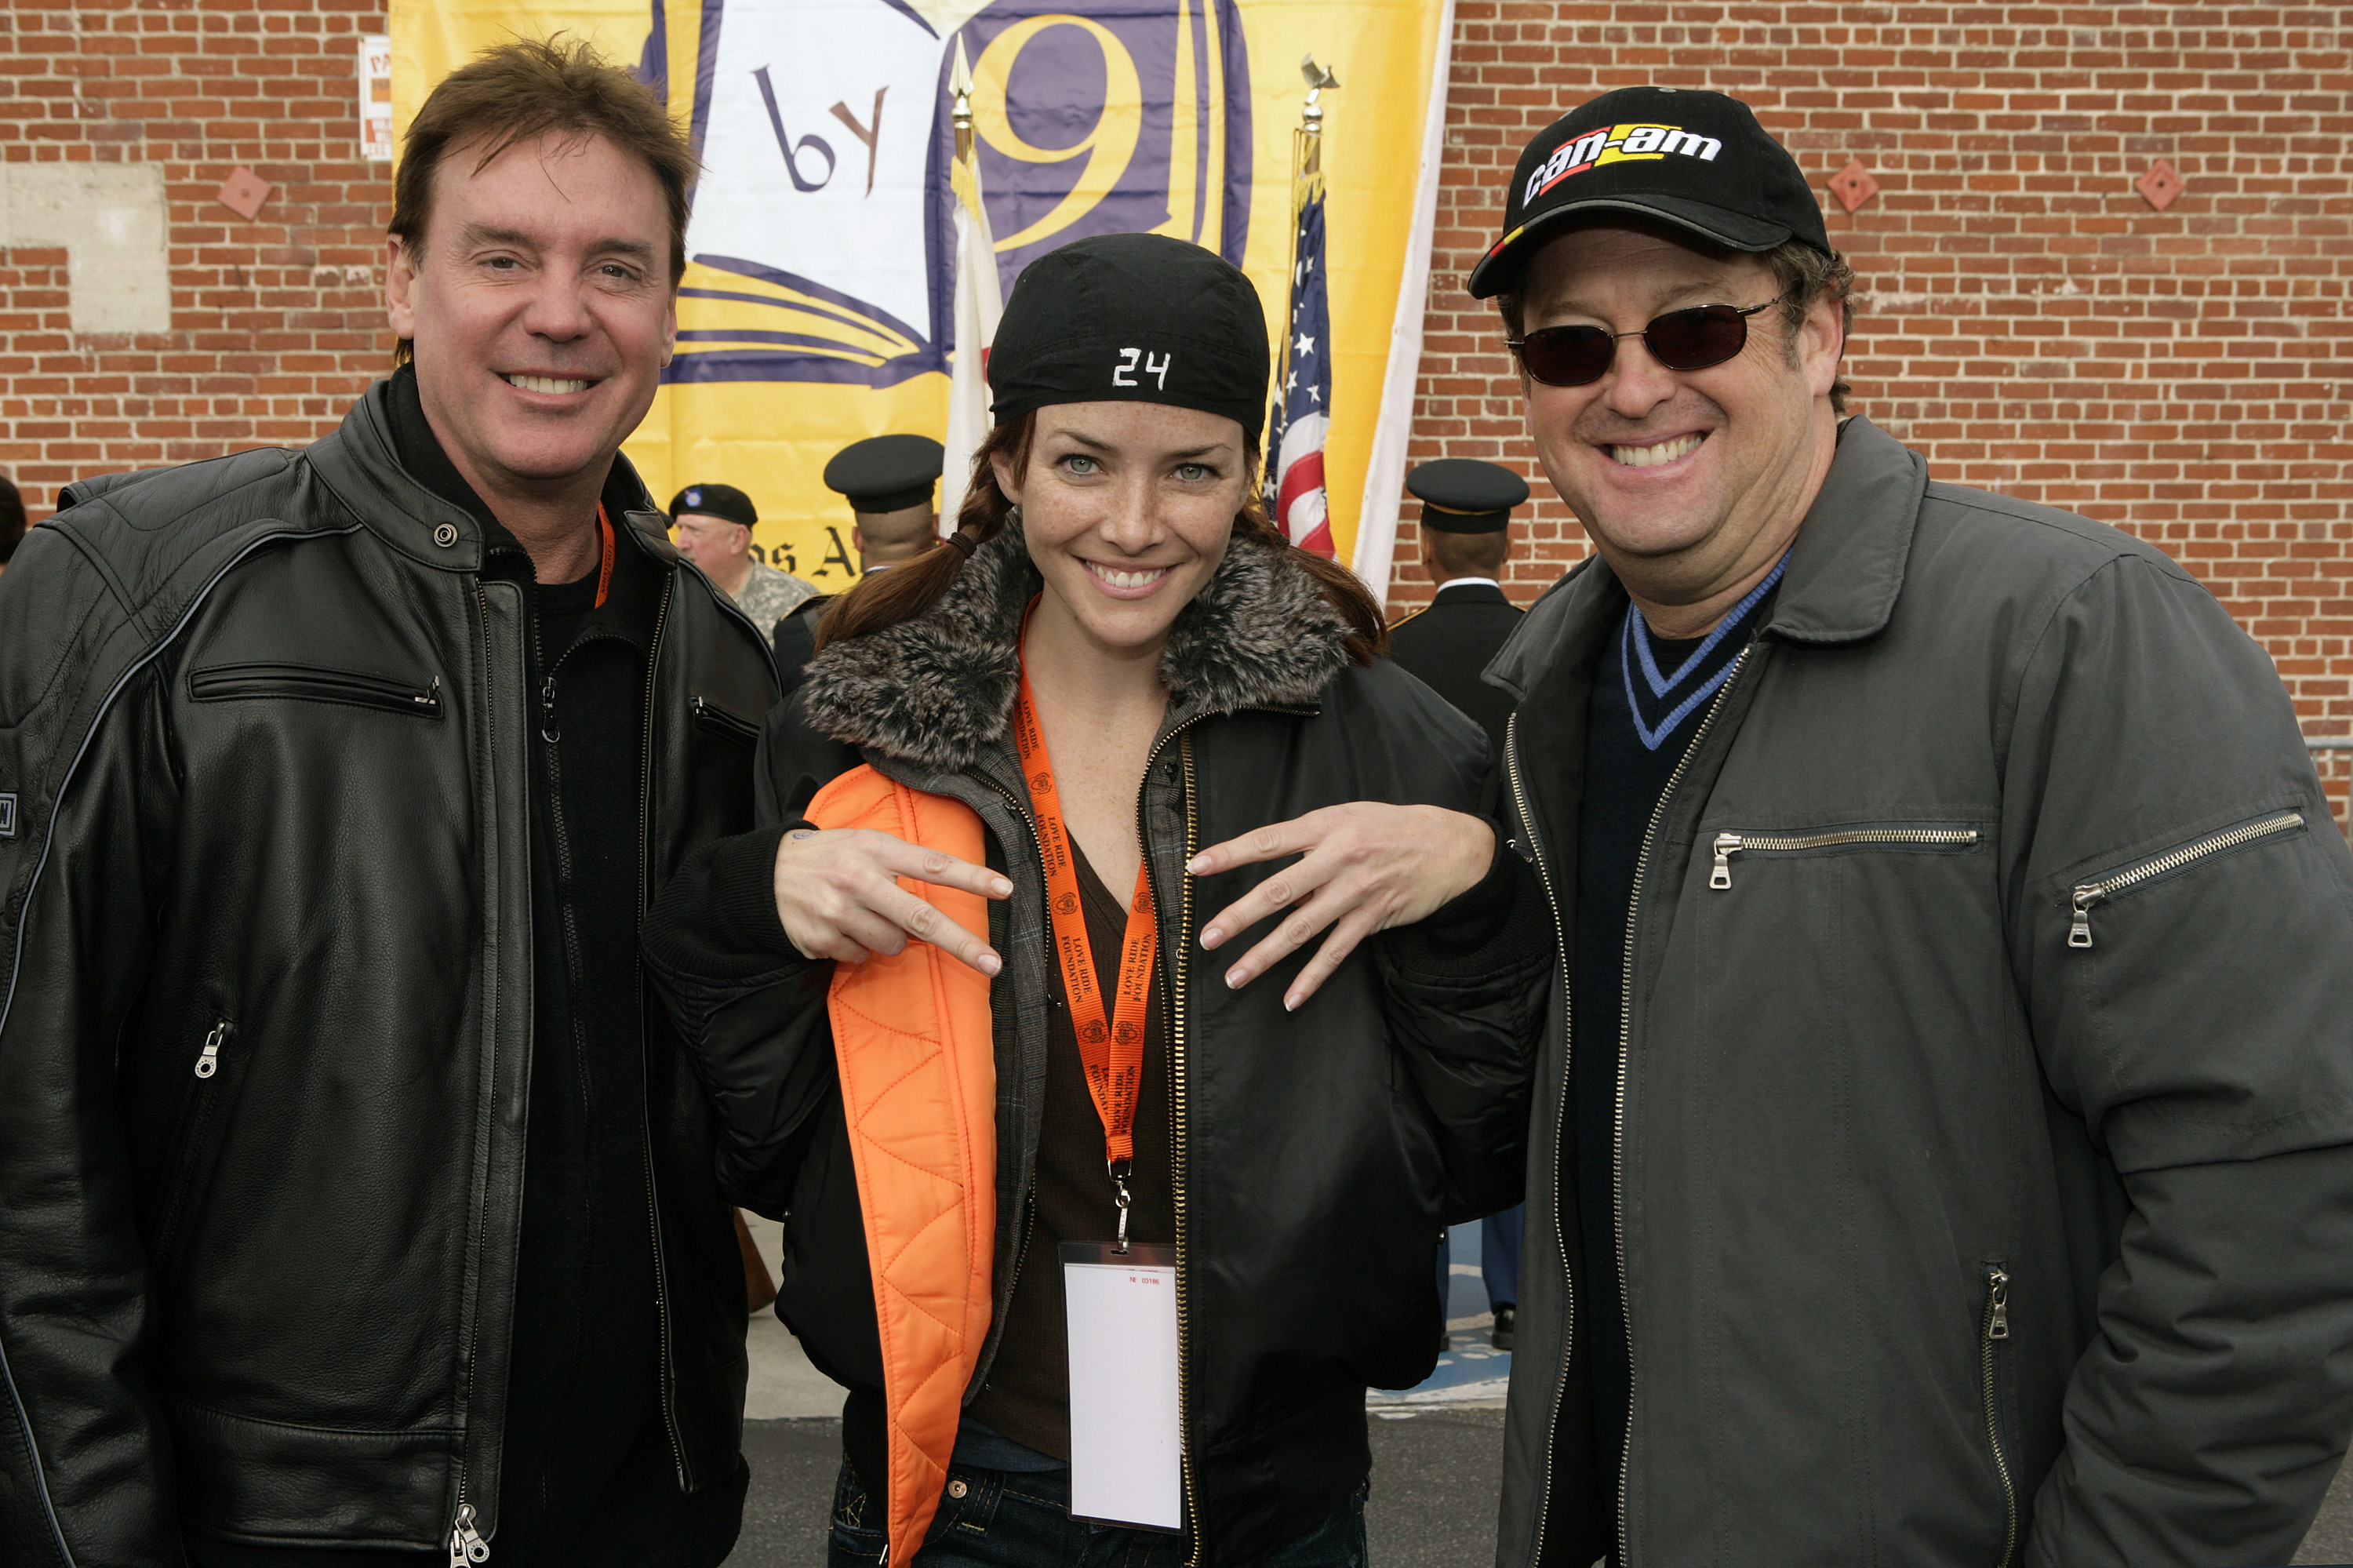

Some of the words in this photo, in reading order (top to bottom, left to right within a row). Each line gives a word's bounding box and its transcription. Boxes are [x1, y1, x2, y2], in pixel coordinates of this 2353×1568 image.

[749, 63, 889, 199] by
[969, 13, 1143, 253] 9
[1522, 127, 1722, 210] can-am
[1112, 347, 1171, 391] 24
[1023, 700, 1032, 726] LOVE
[1029, 726, 1038, 751] RIDE
[1036, 813, 1057, 877] FOUNDATION
[1048, 817, 1060, 842] LOVE
[1055, 844, 1067, 868] RIDE
[1061, 936, 1083, 1003] FOUNDATION
[1073, 937, 1086, 966] LOVE
[1128, 938, 1140, 963] RIDE
[1133, 933, 1152, 1002] FOUNDATION
[1079, 968, 1093, 995] RIDE
[1123, 966, 1135, 995] LOVE
[1115, 1071, 1124, 1097] RIDE
[1114, 1100, 1122, 1130] LOVE
